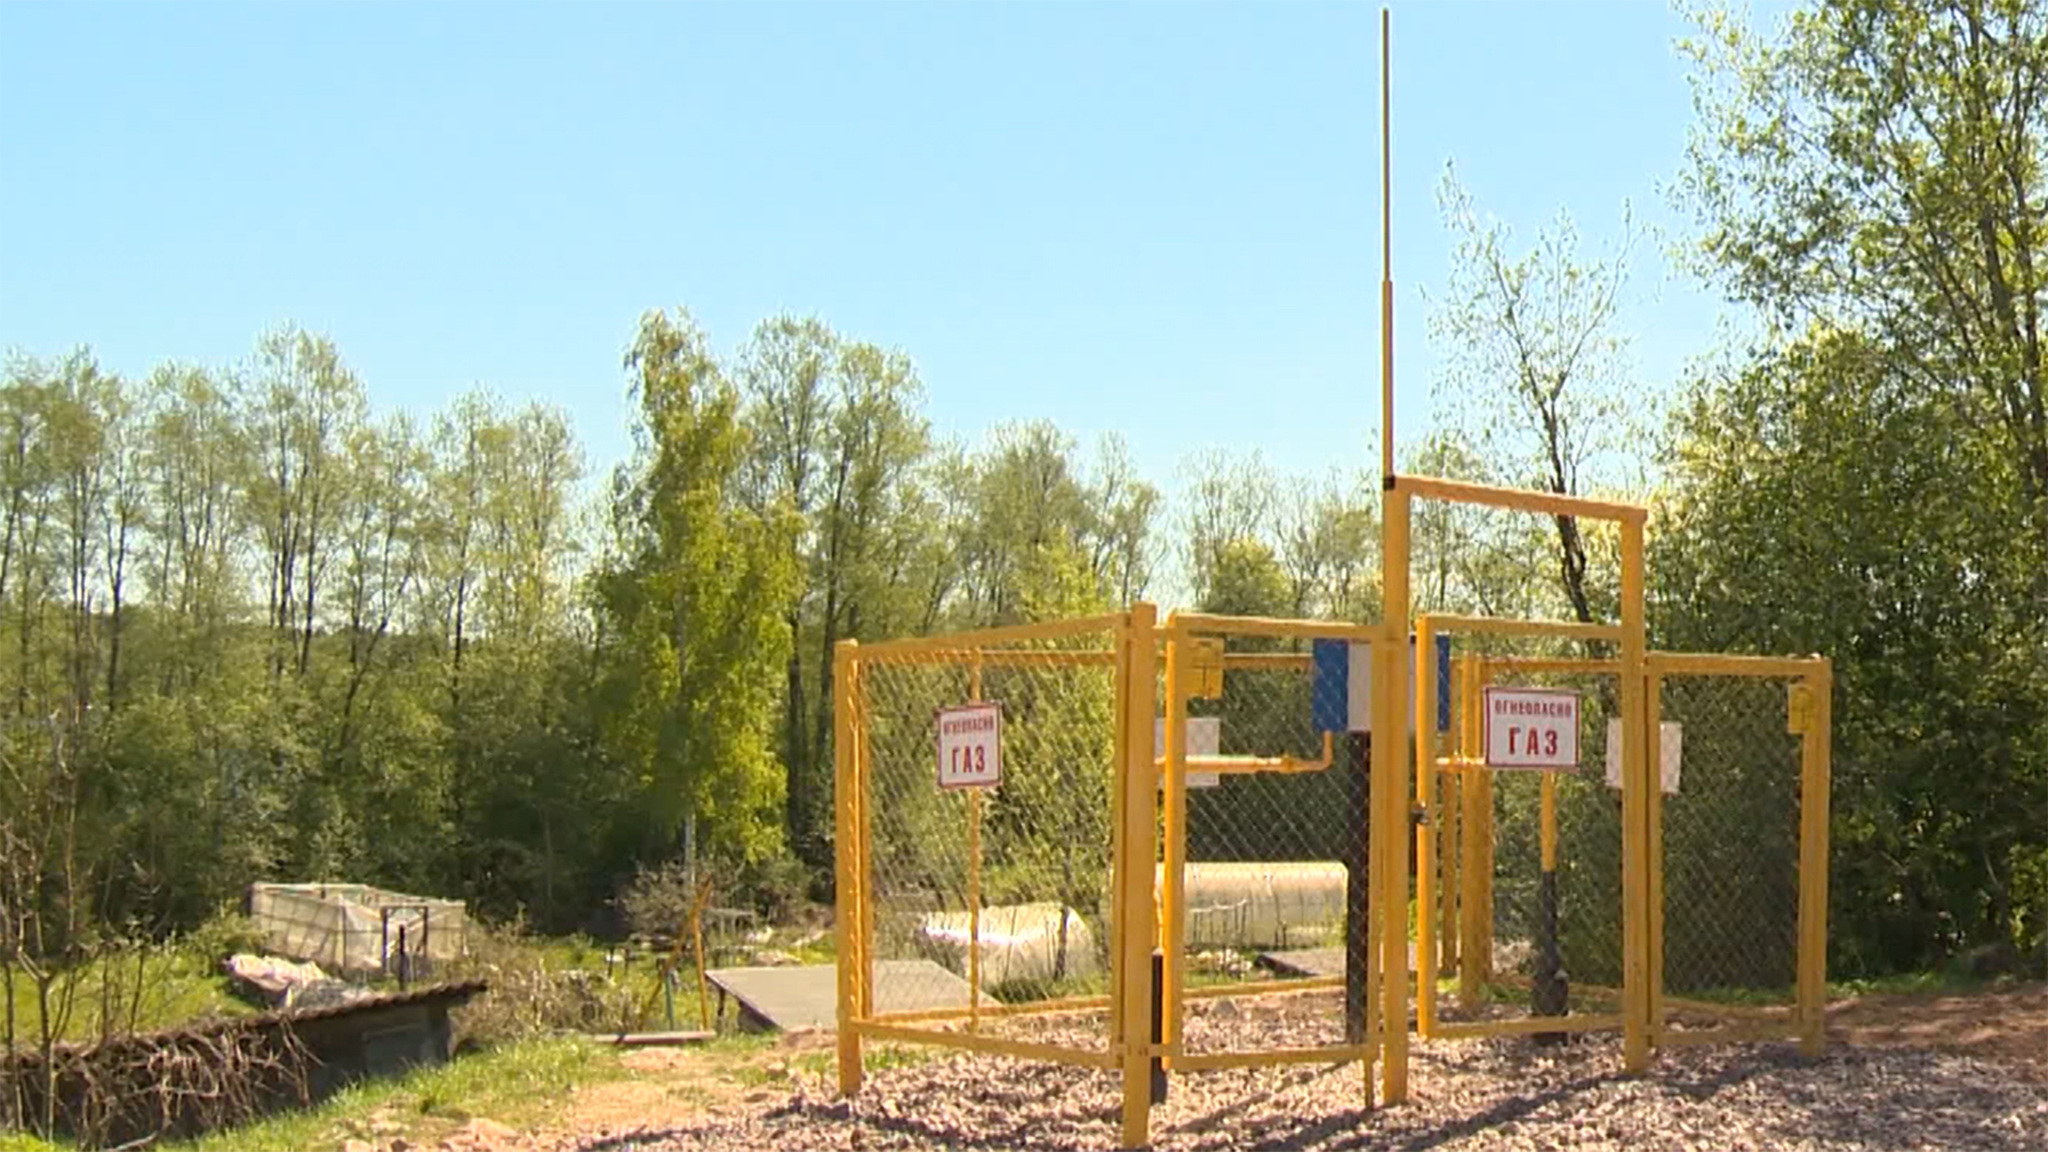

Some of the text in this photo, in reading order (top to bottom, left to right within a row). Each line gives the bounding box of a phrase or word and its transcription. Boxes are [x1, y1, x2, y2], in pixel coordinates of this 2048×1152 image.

[1495, 699, 1572, 718] ОГНЕОПАСНО
[1509, 726, 1557, 756] ГАЗ
[952, 745, 985, 774] ГАЗ
